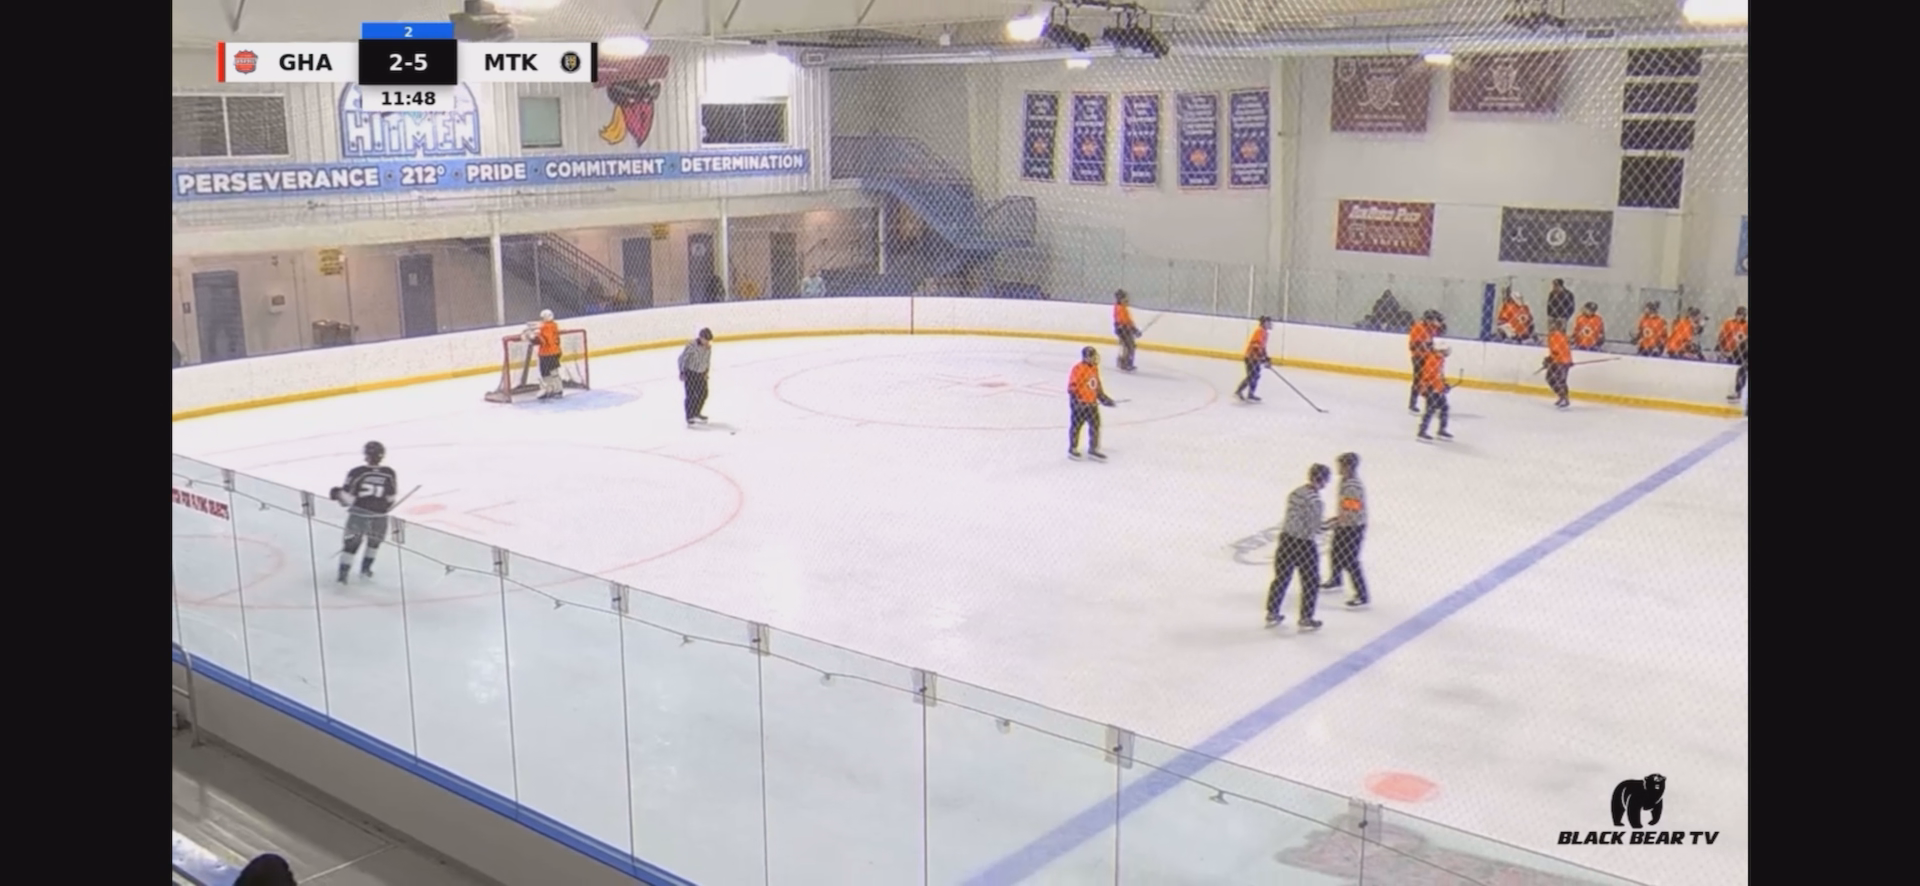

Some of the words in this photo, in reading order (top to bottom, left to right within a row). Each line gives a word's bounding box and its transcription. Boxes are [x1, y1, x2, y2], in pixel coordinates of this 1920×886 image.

[345, 112, 477, 152] HITMEN
[177, 167, 379, 194] PERSEVERANCE
[467, 162, 527, 182] PRIDE
[545, 158, 665, 179] COMMITMENT
[681, 153, 804, 173] DETERMINATION
